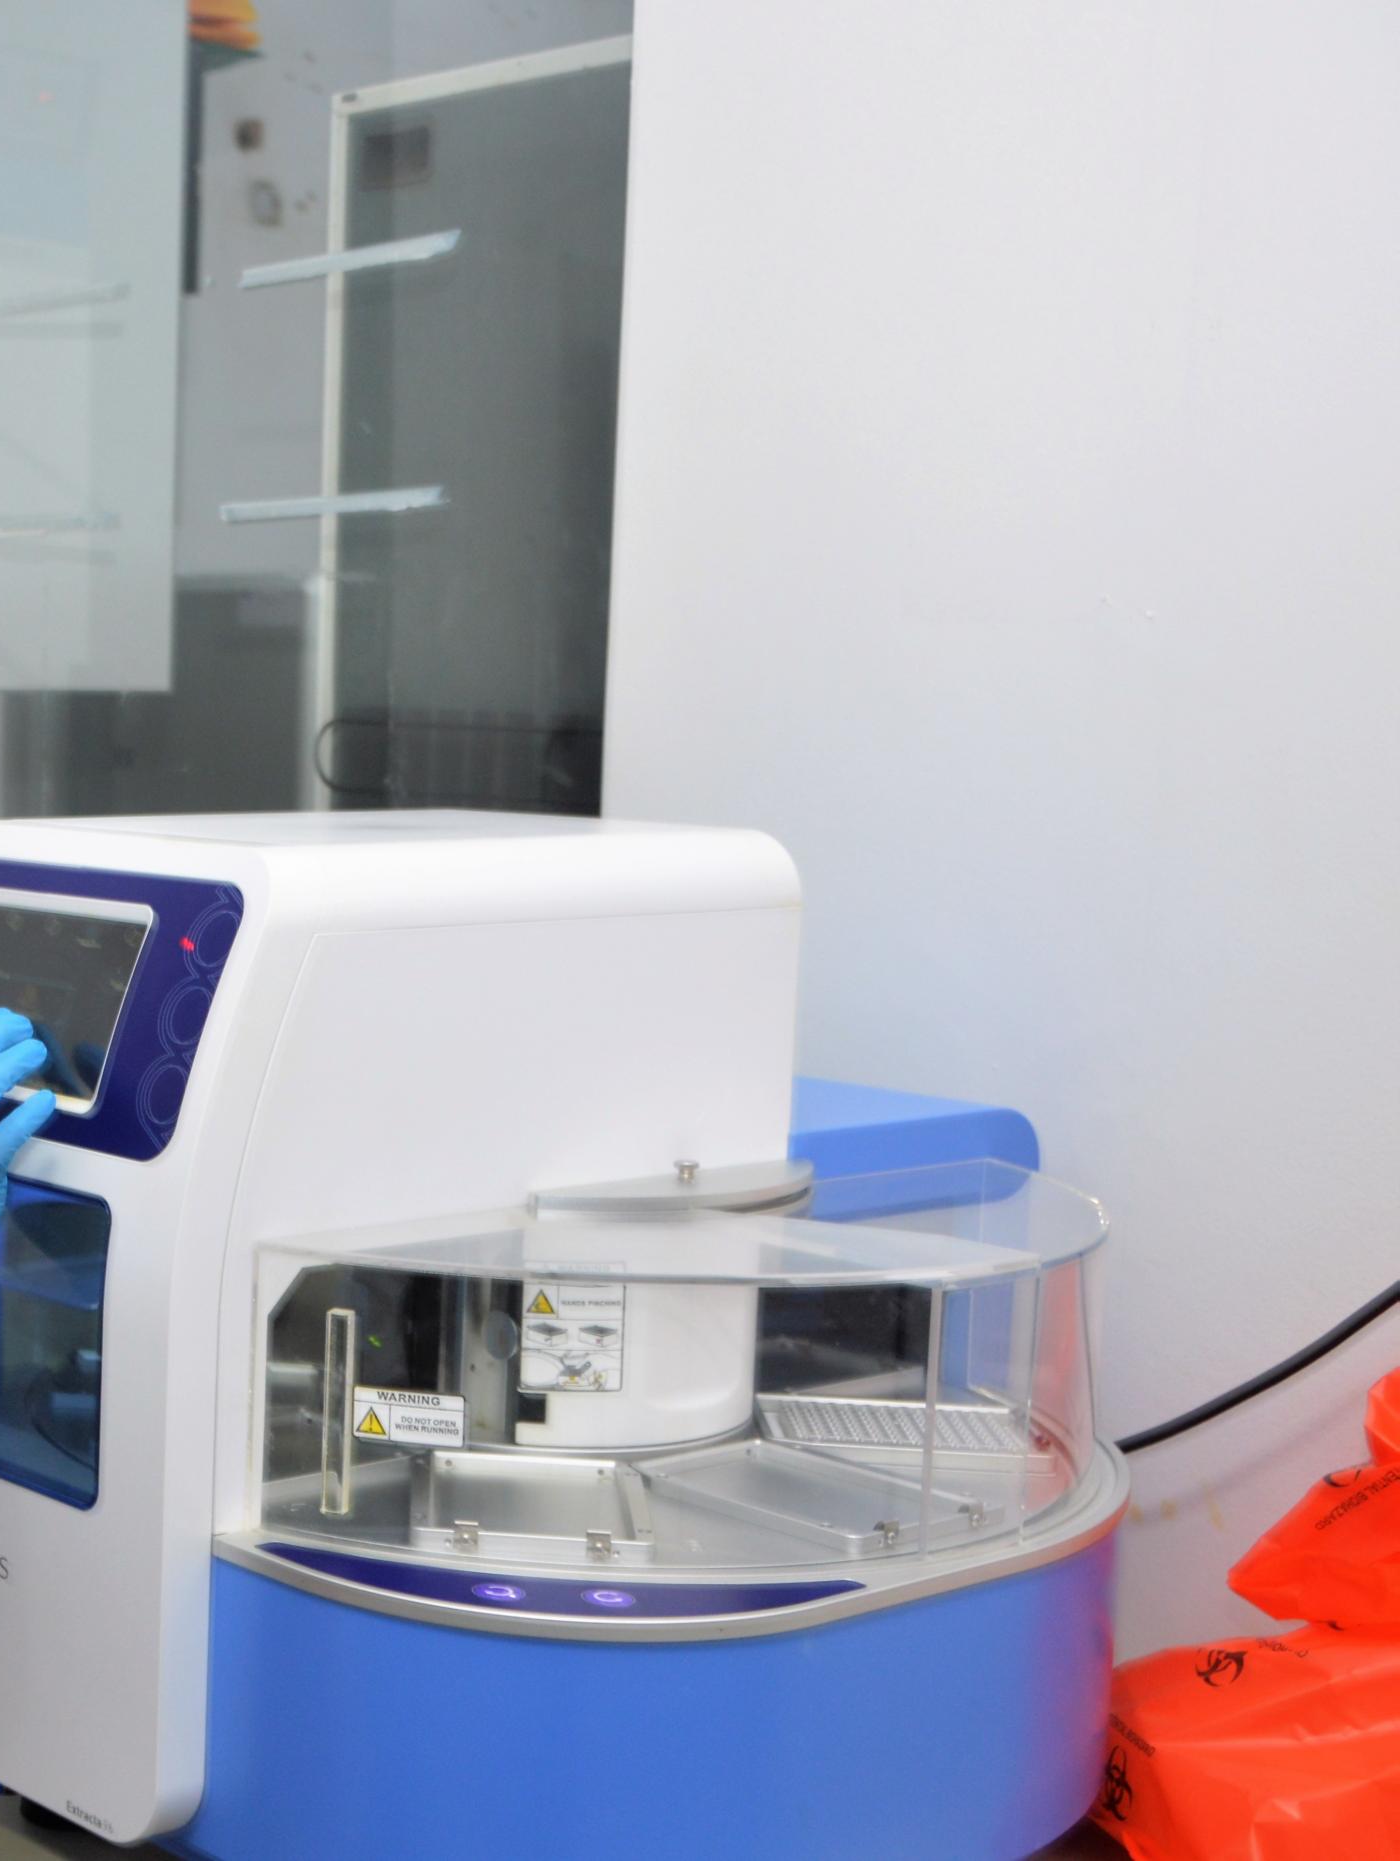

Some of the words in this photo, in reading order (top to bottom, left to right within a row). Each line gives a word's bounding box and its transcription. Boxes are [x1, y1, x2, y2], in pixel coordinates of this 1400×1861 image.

[377, 1391, 441, 1406] WARNING
[401, 1416, 413, 1424] DO
[415, 1417, 431, 1425] NOT
[432, 1419, 457, 1428] OPEN
[395, 1423, 419, 1433] WHEN
[420, 1426, 460, 1436] RUNNING
